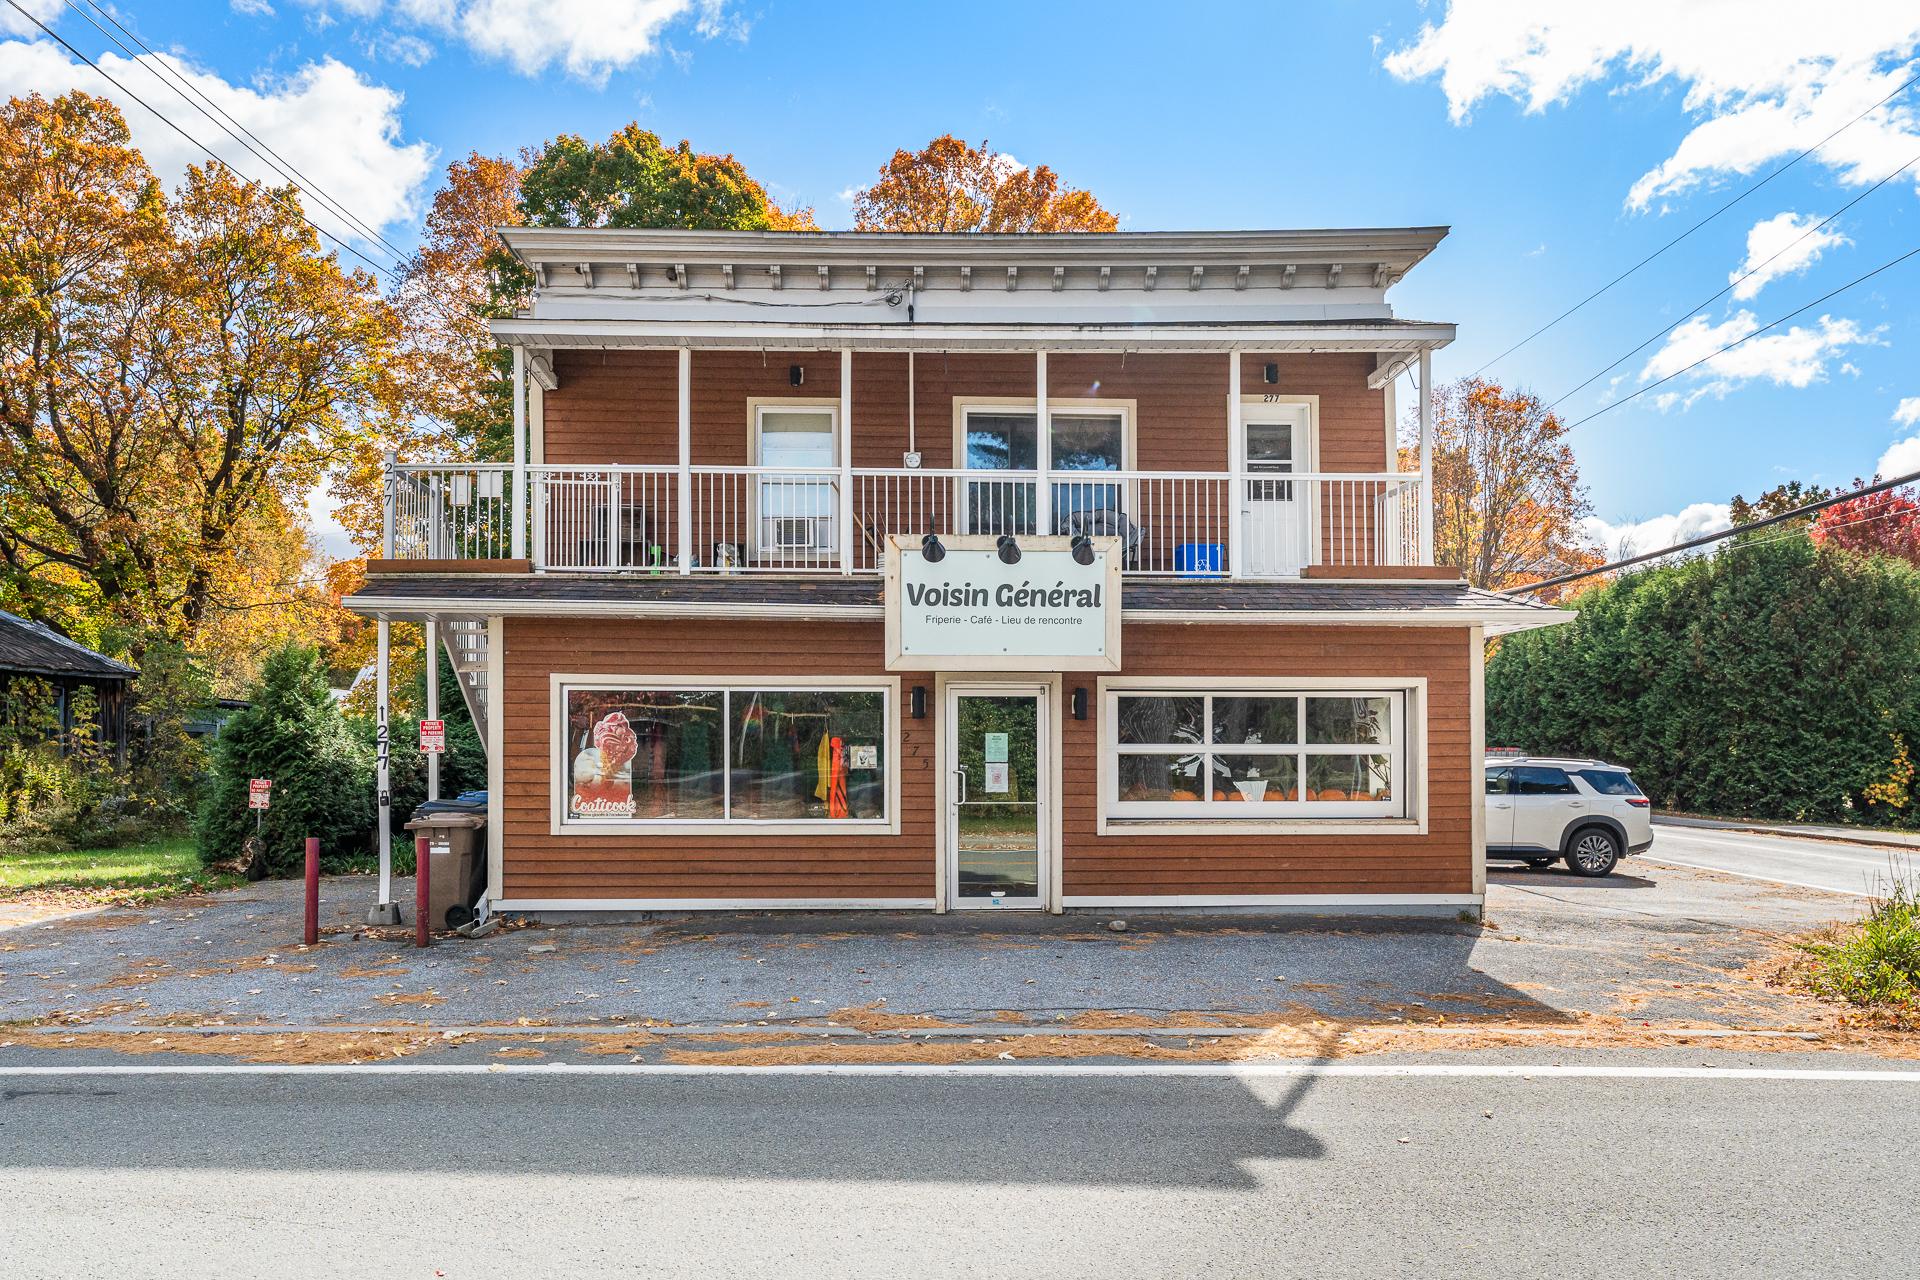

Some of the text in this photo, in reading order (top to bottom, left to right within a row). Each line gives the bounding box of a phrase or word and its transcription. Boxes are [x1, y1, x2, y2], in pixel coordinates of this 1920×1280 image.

[1264, 394, 1280, 403] 277
[384, 462, 393, 507] 277
[906, 580, 1102, 608] Voisin Général
[925, 614, 962, 626] Friperie
[970, 615, 993, 625] Café
[1001, 615, 1022, 625] Lieu
[1024, 615, 1036, 625] de
[1038, 616, 1083, 625] rencontre
[376, 724, 389, 770] 277
[902, 731, 929, 770] 275
[571, 793, 637, 814] Coaticook
